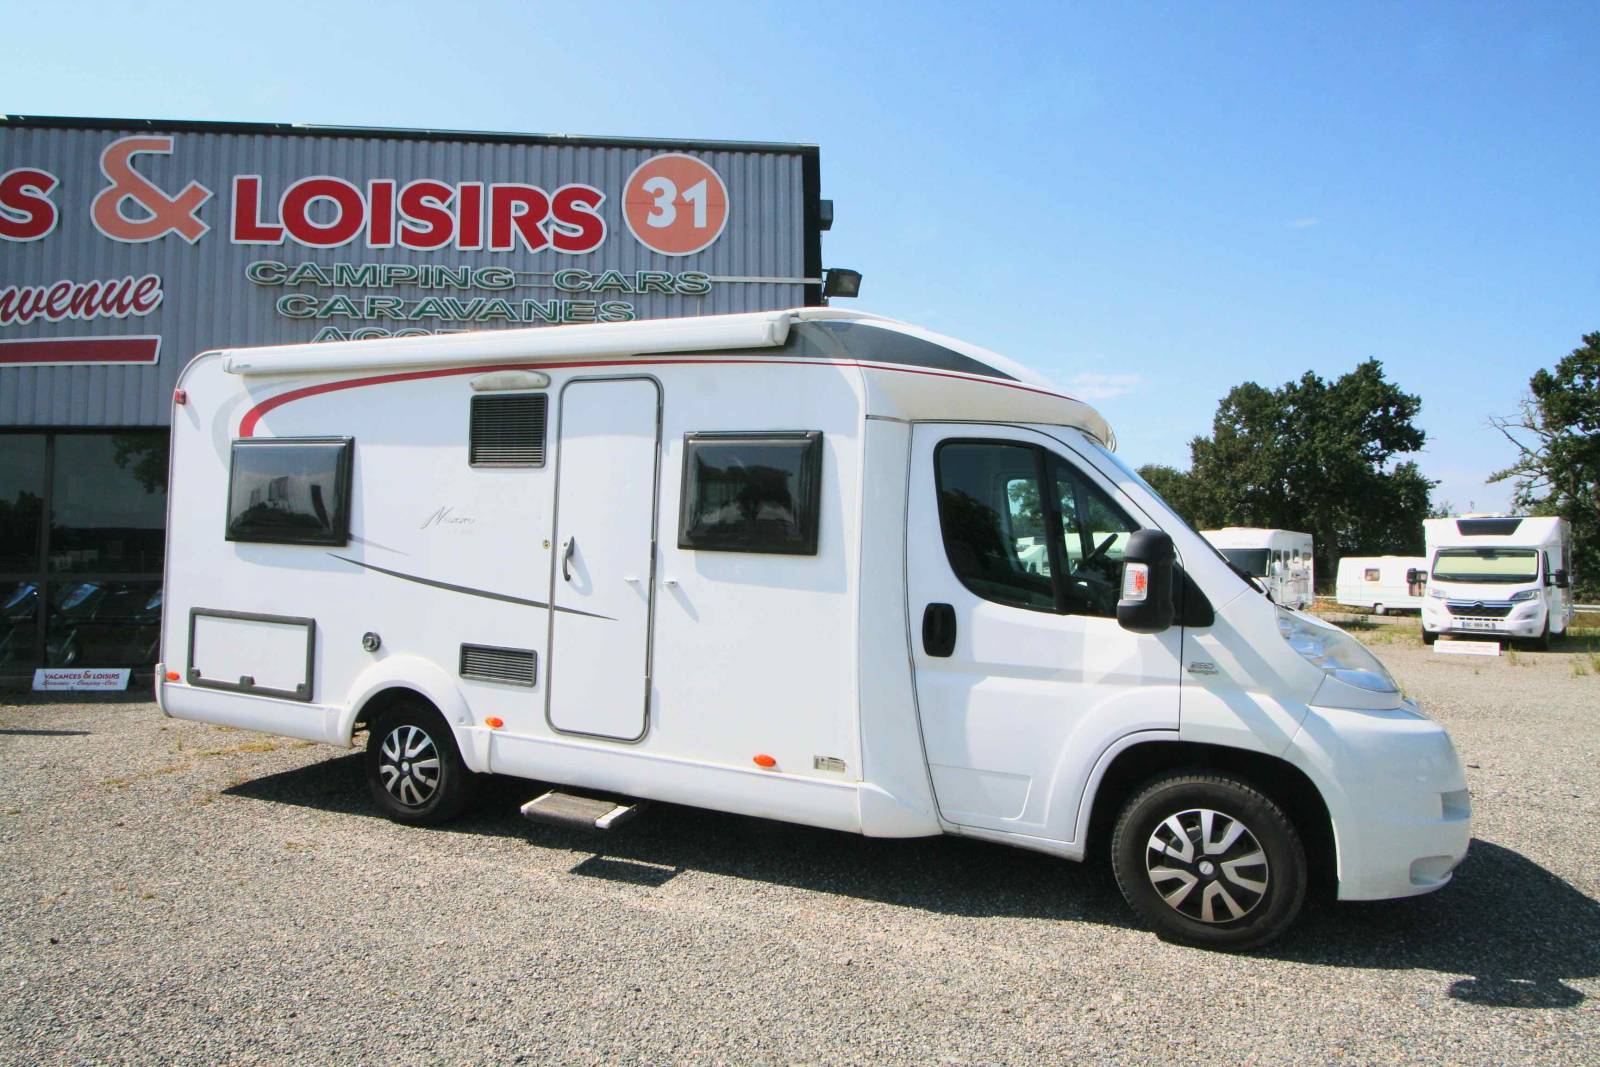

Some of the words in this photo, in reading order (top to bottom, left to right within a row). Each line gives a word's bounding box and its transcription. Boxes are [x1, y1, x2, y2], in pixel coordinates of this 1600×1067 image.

[90, 136, 213, 245] &
[231, 175, 607, 255] LOISIRS
[642, 176, 707, 229] 31
[245, 260, 515, 291] CAMPING
[553, 268, 712, 295] CARS
[277, 295, 636, 324] CARAVANES
[44, 672, 82, 680] VACANCES
[82, 670, 92, 680] &
[93, 672, 120, 680] LOISIRS
